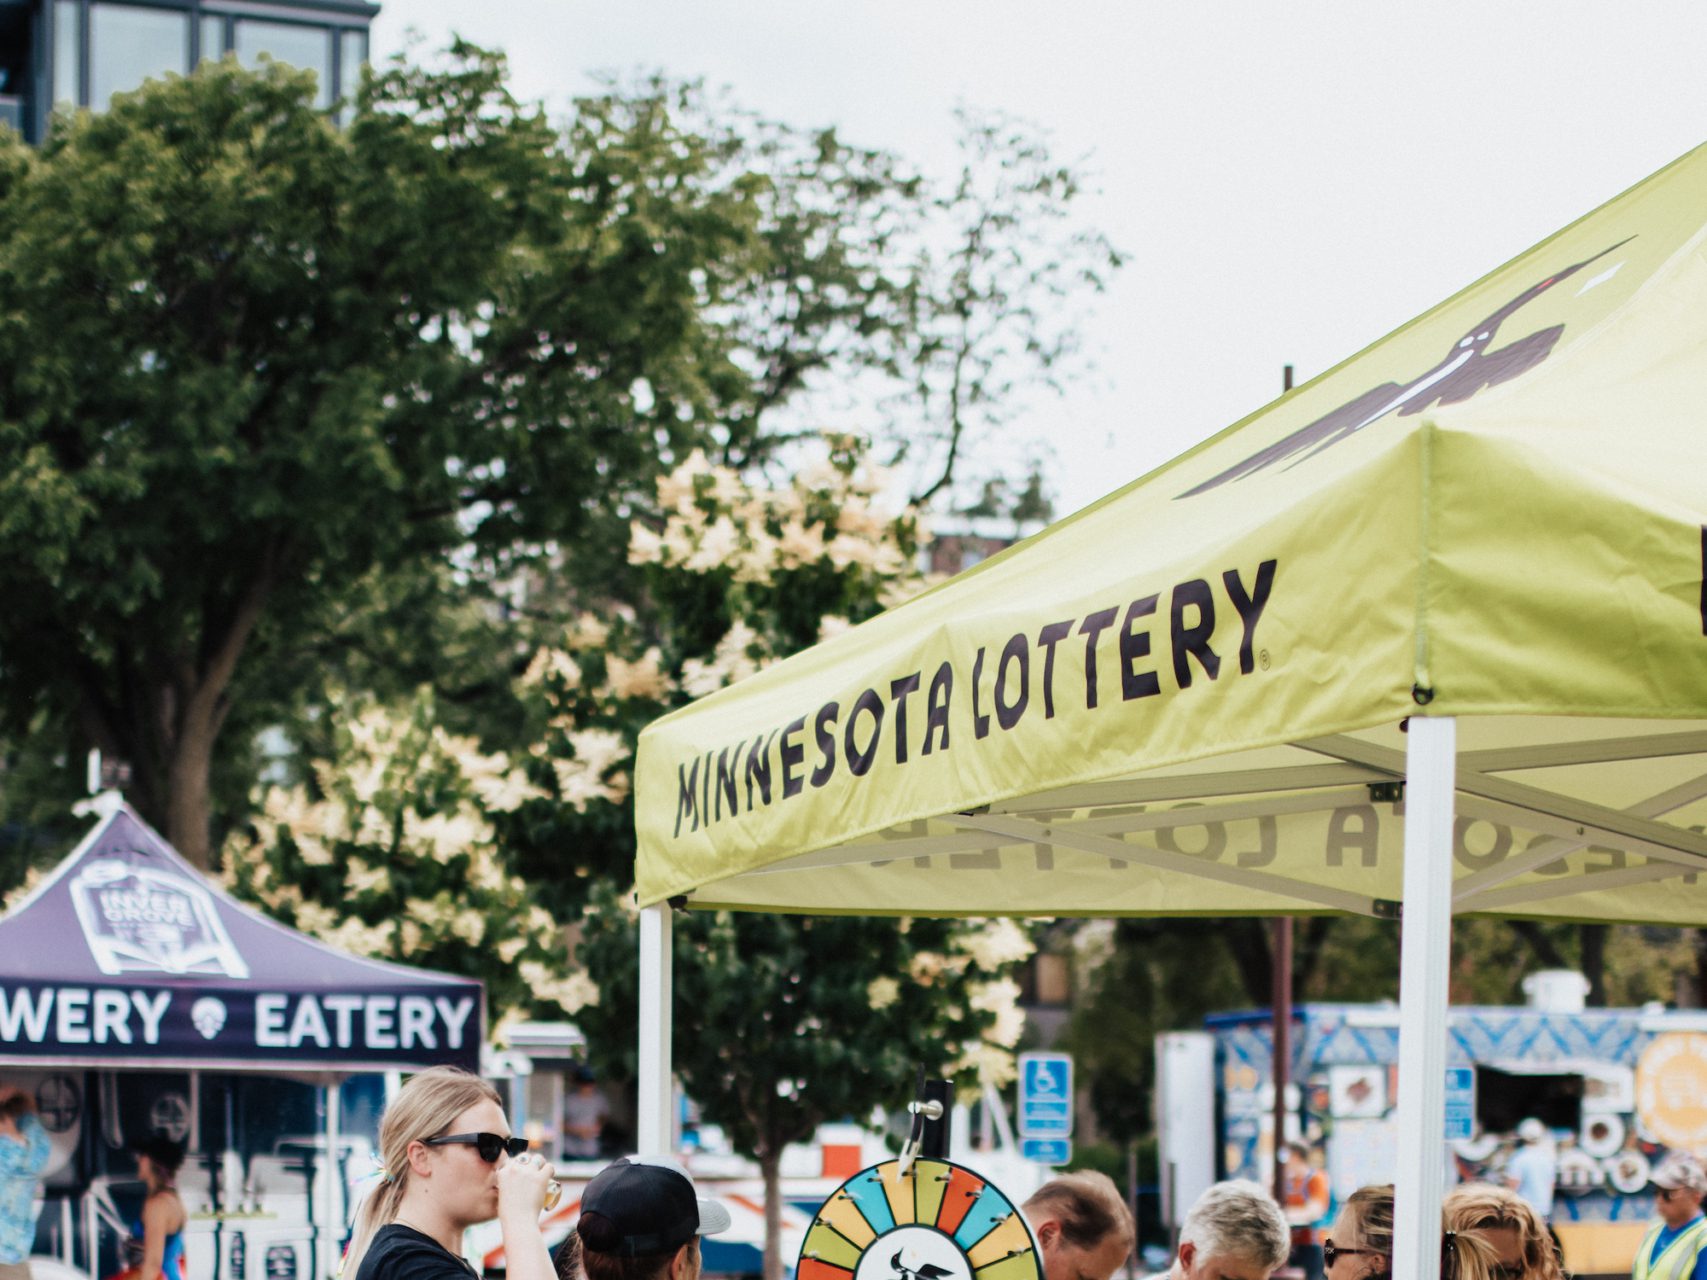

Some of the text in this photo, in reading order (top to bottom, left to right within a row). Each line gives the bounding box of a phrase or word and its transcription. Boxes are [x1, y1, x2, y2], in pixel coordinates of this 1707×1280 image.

[674, 559, 1278, 839] MINNESOTA LOTTERY
[0, 985, 475, 1050] WERY EATERY
